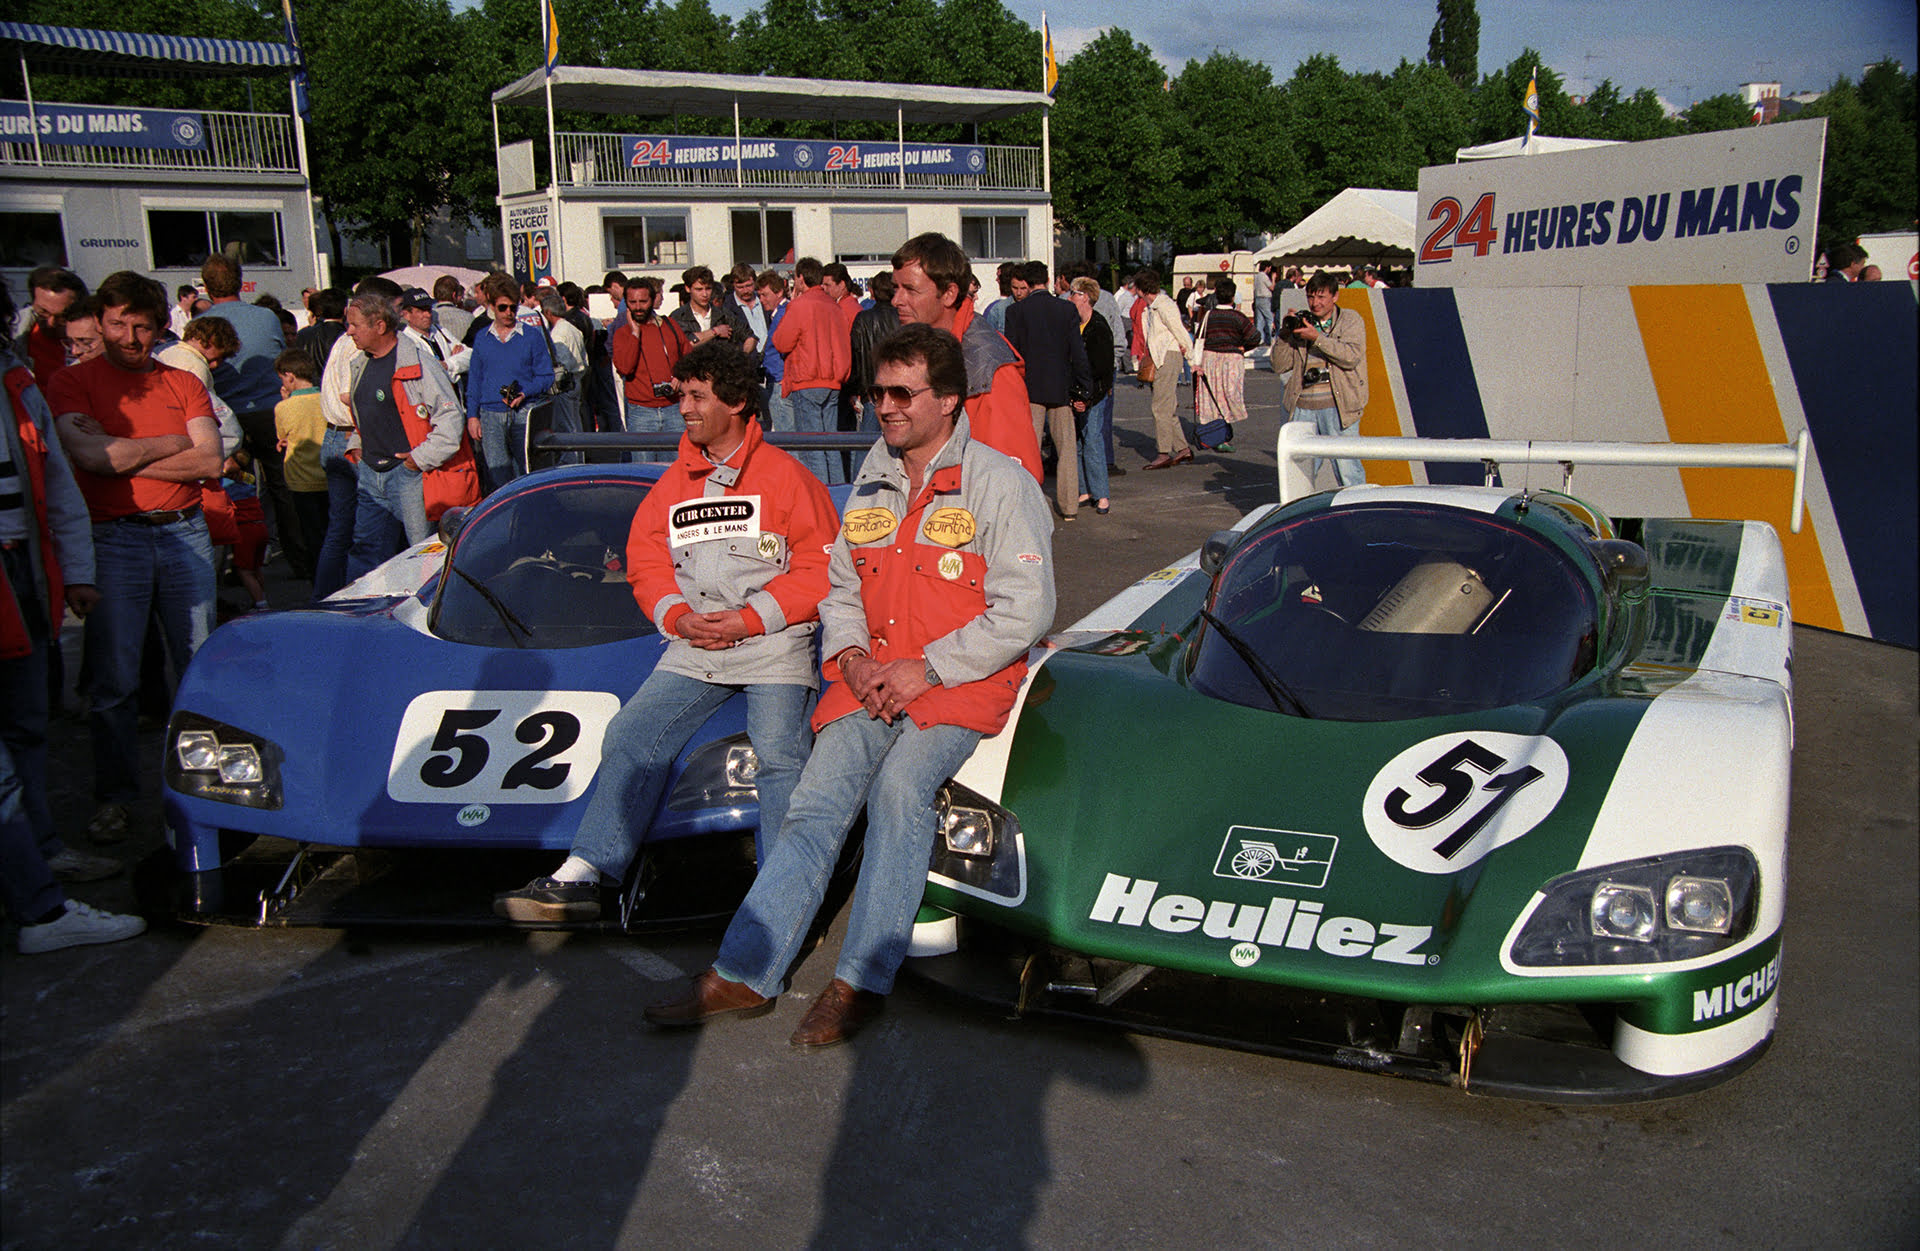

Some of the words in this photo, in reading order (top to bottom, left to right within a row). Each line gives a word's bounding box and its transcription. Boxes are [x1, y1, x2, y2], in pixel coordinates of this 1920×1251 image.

[0, 114, 52, 135] URS
[57, 114, 84, 134] DU
[88, 113, 143, 133] MANS
[631, 139, 672, 167] 24
[675, 146, 719, 164] HEURES
[722, 145, 739, 161] DU
[741, 143, 776, 160] MANS
[825, 145, 861, 171] 24
[863, 151, 901, 168] HEURES
[904, 150, 920, 165] DU
[921, 149, 953, 165] MANS
[509, 204, 548, 217] AUTOMOBILES
[1418, 191, 1498, 265] 24
[1502, 200, 1615, 255] HEURES
[1617, 192, 1671, 245] DU
[1674, 174, 1803, 240] MANS
[509, 214, 548, 230] PEUGEOT
[676, 509, 699, 523] CUIR
[700, 505, 747, 519] CENTER
[677, 529, 700, 540] ANGERS
[703, 527, 709, 535] &
[714, 526, 722, 534] LE
[725, 524, 748, 533] MANS
[759, 536, 777, 556] WM
[941, 556, 961, 577] WM
[419, 708, 582, 790] 52
[1383, 738, 1545, 861] 51
[462, 810, 485, 821] WM
[1089, 872, 1433, 966] Heuliez
[1234, 947, 1257, 960] WM
